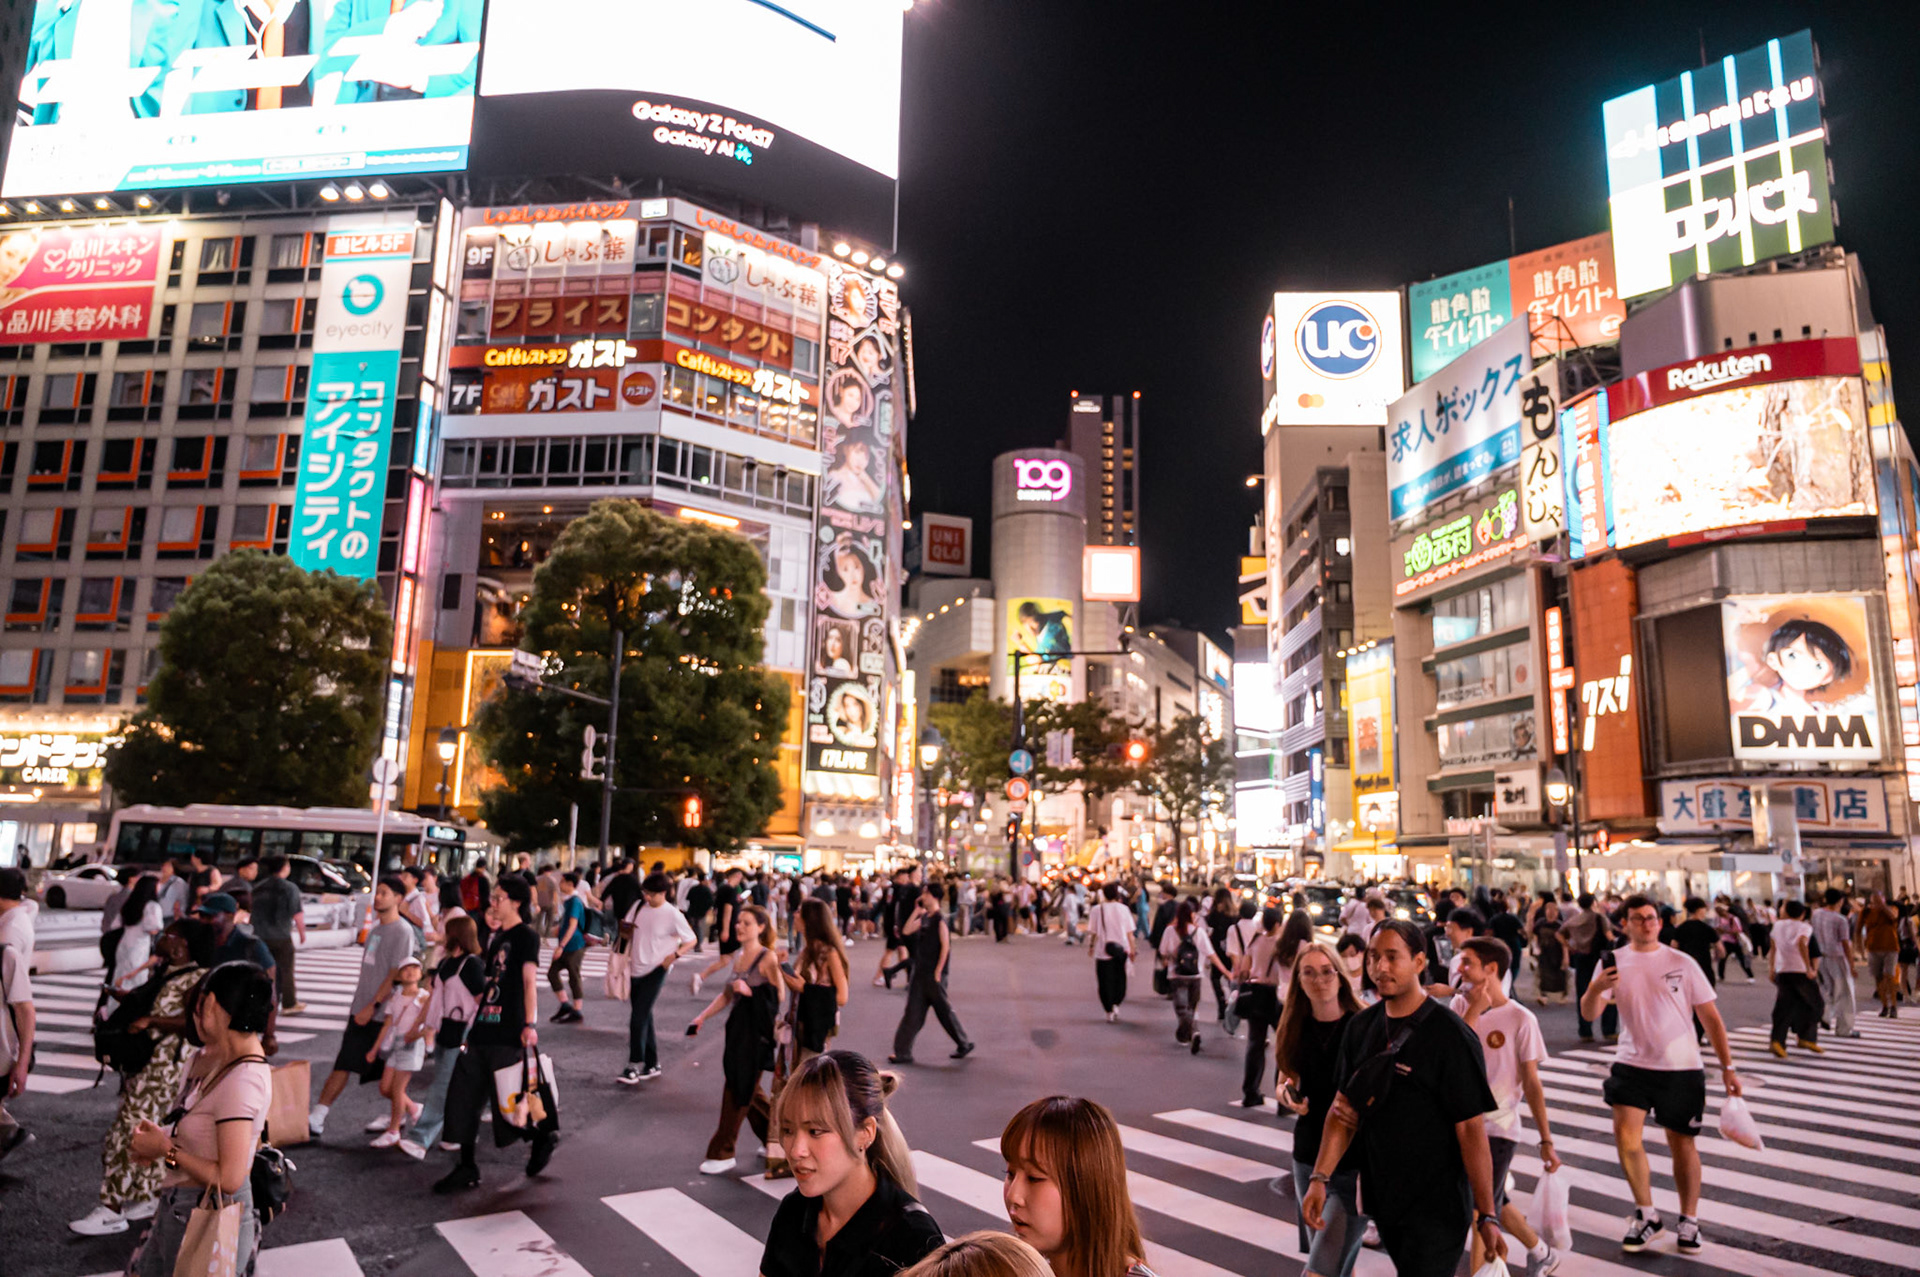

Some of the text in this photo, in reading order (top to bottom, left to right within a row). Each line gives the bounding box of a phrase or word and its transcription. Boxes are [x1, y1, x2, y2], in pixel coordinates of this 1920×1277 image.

[632, 100, 775, 149] Galaxy Z Fold7
[653, 126, 735, 158] Galaxy AI
[483, 200, 630, 224] しゃぶしゃぶバイキング
[1655, 170, 1818, 258] ロンパス
[67, 236, 155, 260] 品川スキン
[467, 246, 493, 266] 9F
[544, 236, 626, 263] しゃぶ葉
[65, 257, 143, 279] クリニック
[747, 262, 818, 308] しゃぶ葉
[1533, 257, 1599, 298] 龍角散
[6, 303, 143, 334] 品川美容外科
[495, 299, 625, 328] プライス
[1528, 286, 1614, 325] ダイレクト
[326, 321, 393, 341] eyecity
[667, 300, 788, 357] コンタクト
[568, 338, 638, 369] ガスト
[751, 368, 810, 405] ガスト
[1667, 353, 1772, 391] Rakuten
[451, 384, 483, 406] 7F
[527, 377, 610, 413] ガスト
[1390, 353, 1524, 463] 求人ボックス
[1523, 376, 1562, 528] もんじゃ
[301, 381, 355, 560] アイシティ
[340, 380, 385, 560] コンタクトの
[1013, 458, 1072, 501] 109
[931, 545, 961, 561] QLO
[932, 528, 960, 545] UNI
[1739, 715, 1873, 748] DMM
